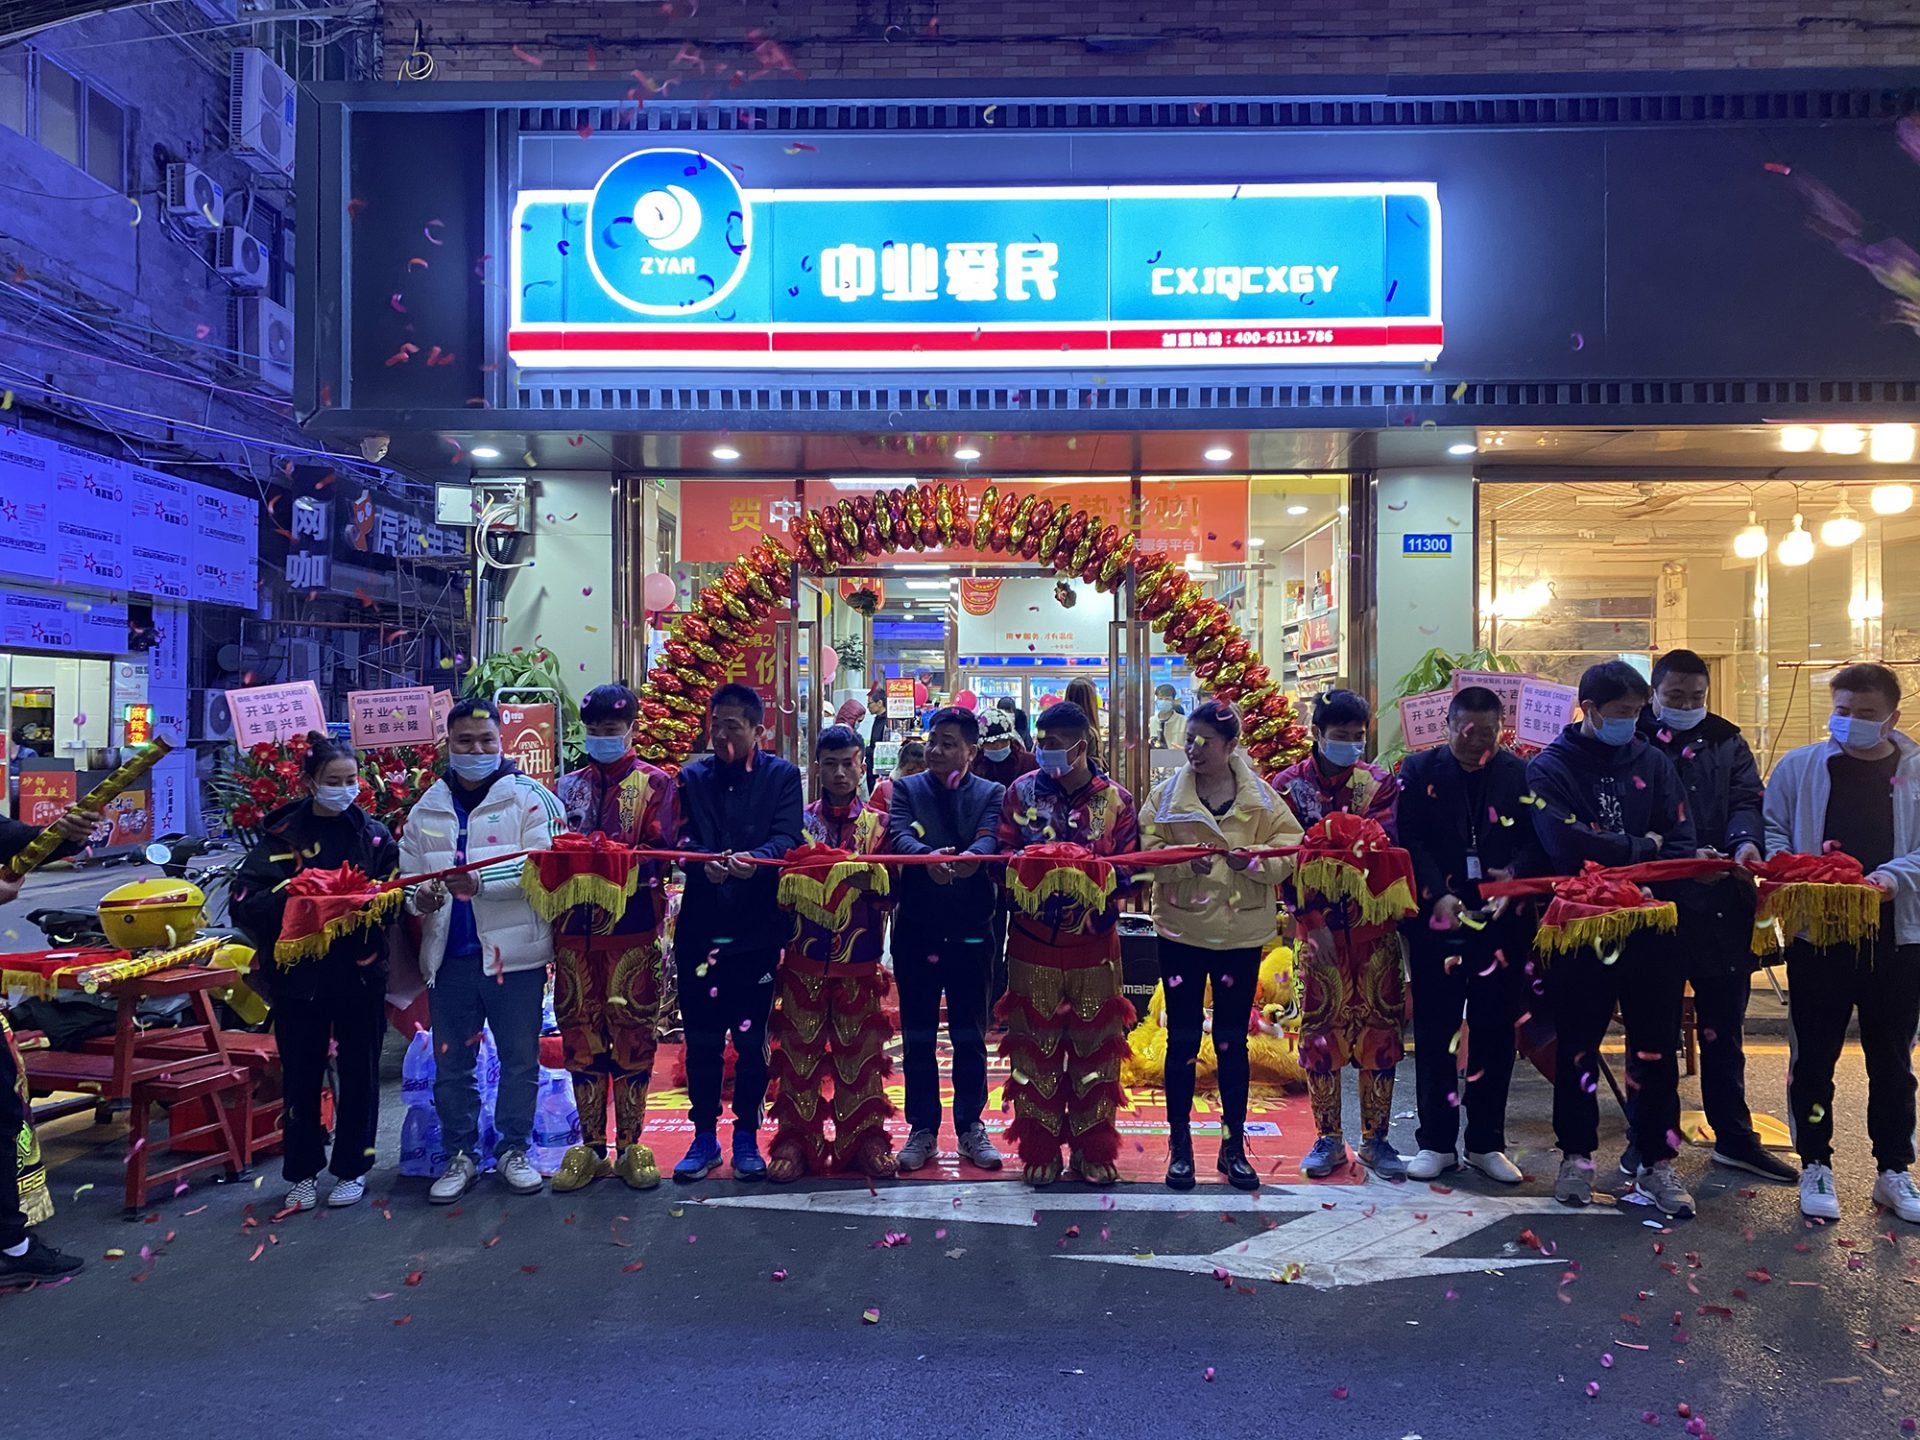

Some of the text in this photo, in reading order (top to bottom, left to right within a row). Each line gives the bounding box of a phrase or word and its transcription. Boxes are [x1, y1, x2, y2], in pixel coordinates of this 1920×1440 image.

[640, 256, 695, 275] ZYAM
[821, 243, 1059, 302] 中业爱民
[1151, 265, 1340, 301] CXJQCXGY
[286, 500, 329, 588] 网咖
[1408, 538, 1448, 551] 11300
[245, 700, 304, 717] 开业大吉
[1524, 699, 1563, 718] 开业大吉
[249, 716, 308, 734] 生意兴隆
[364, 720, 419, 735] 生意兴隆
[1523, 717, 1561, 735] 生意兴隆
[1123, 984, 1157, 995] mala
